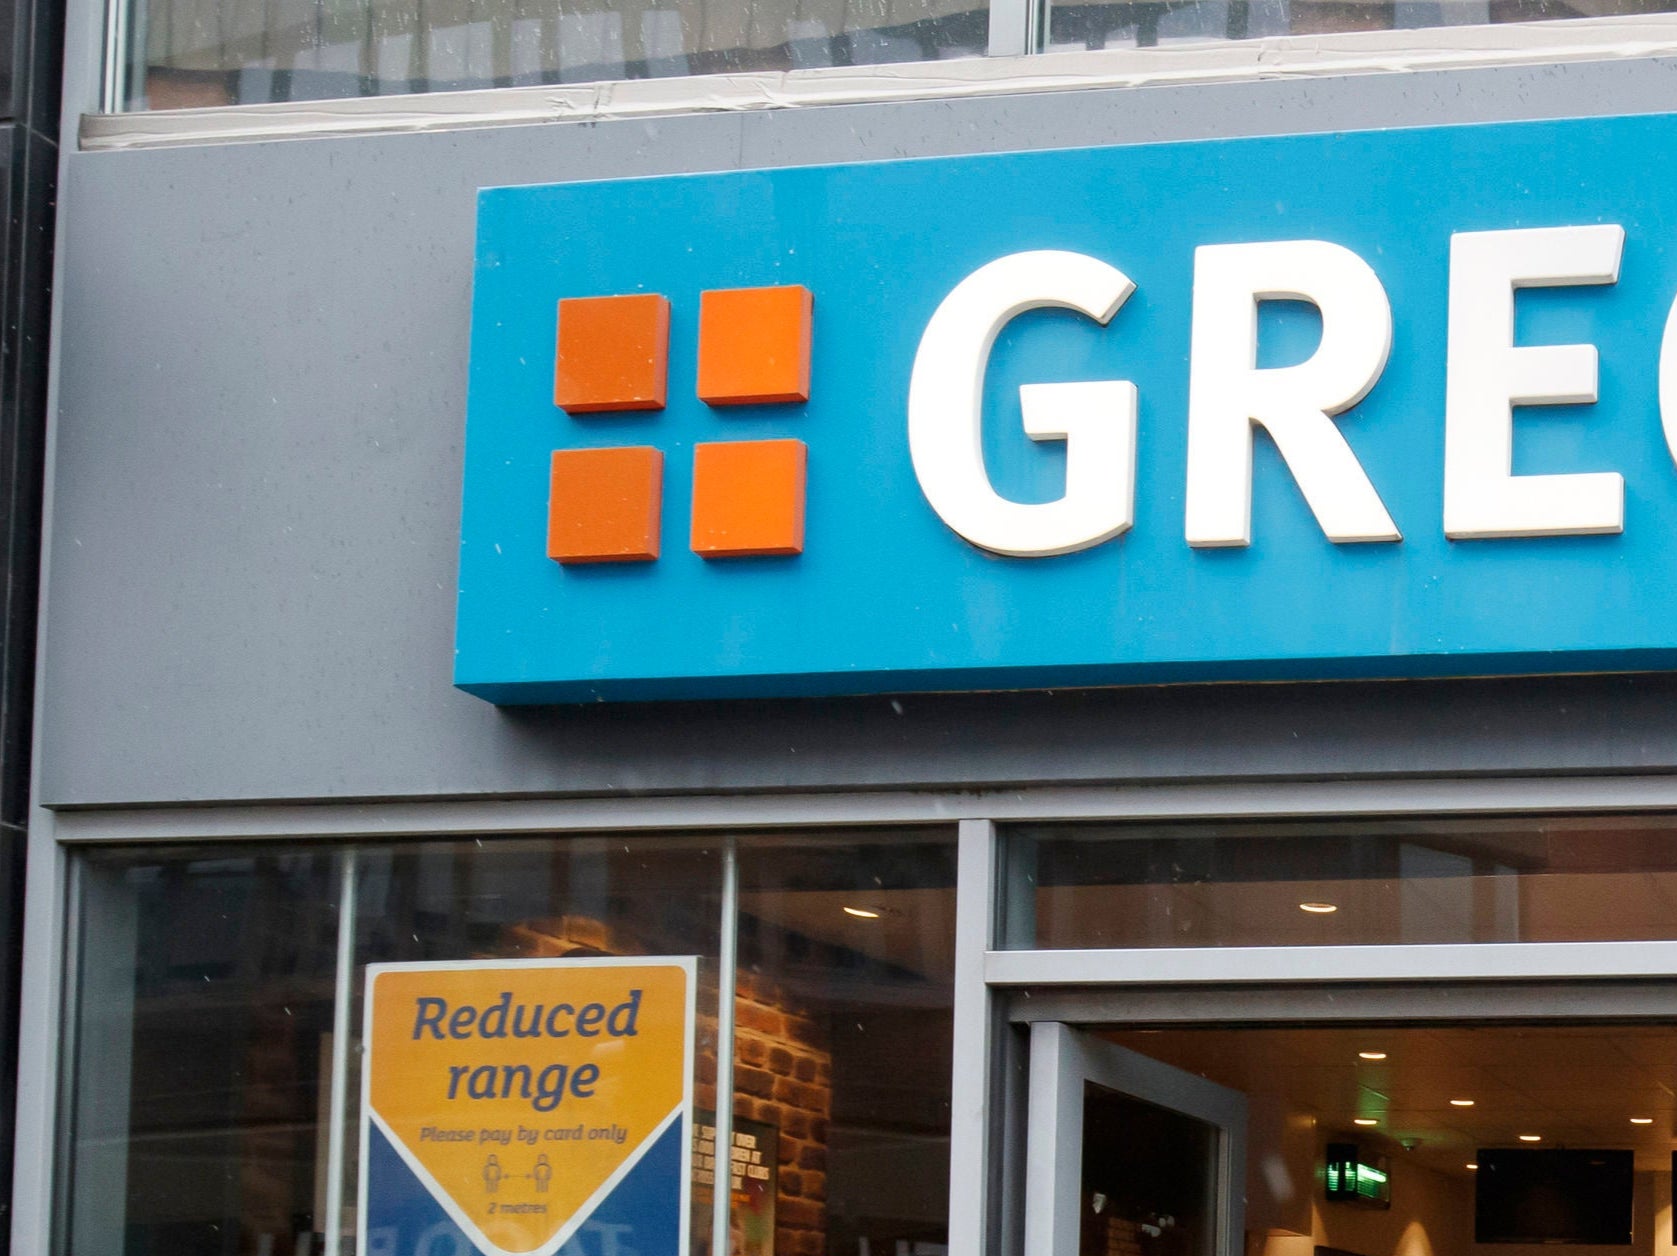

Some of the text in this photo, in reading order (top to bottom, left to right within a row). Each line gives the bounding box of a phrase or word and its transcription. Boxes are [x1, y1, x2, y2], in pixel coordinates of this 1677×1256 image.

[412, 990, 642, 1040] Reduced
[447, 1063, 600, 1112] range
[420, 1124, 627, 1145] Please pay by card only
[488, 1203, 547, 1214] 2 metres
